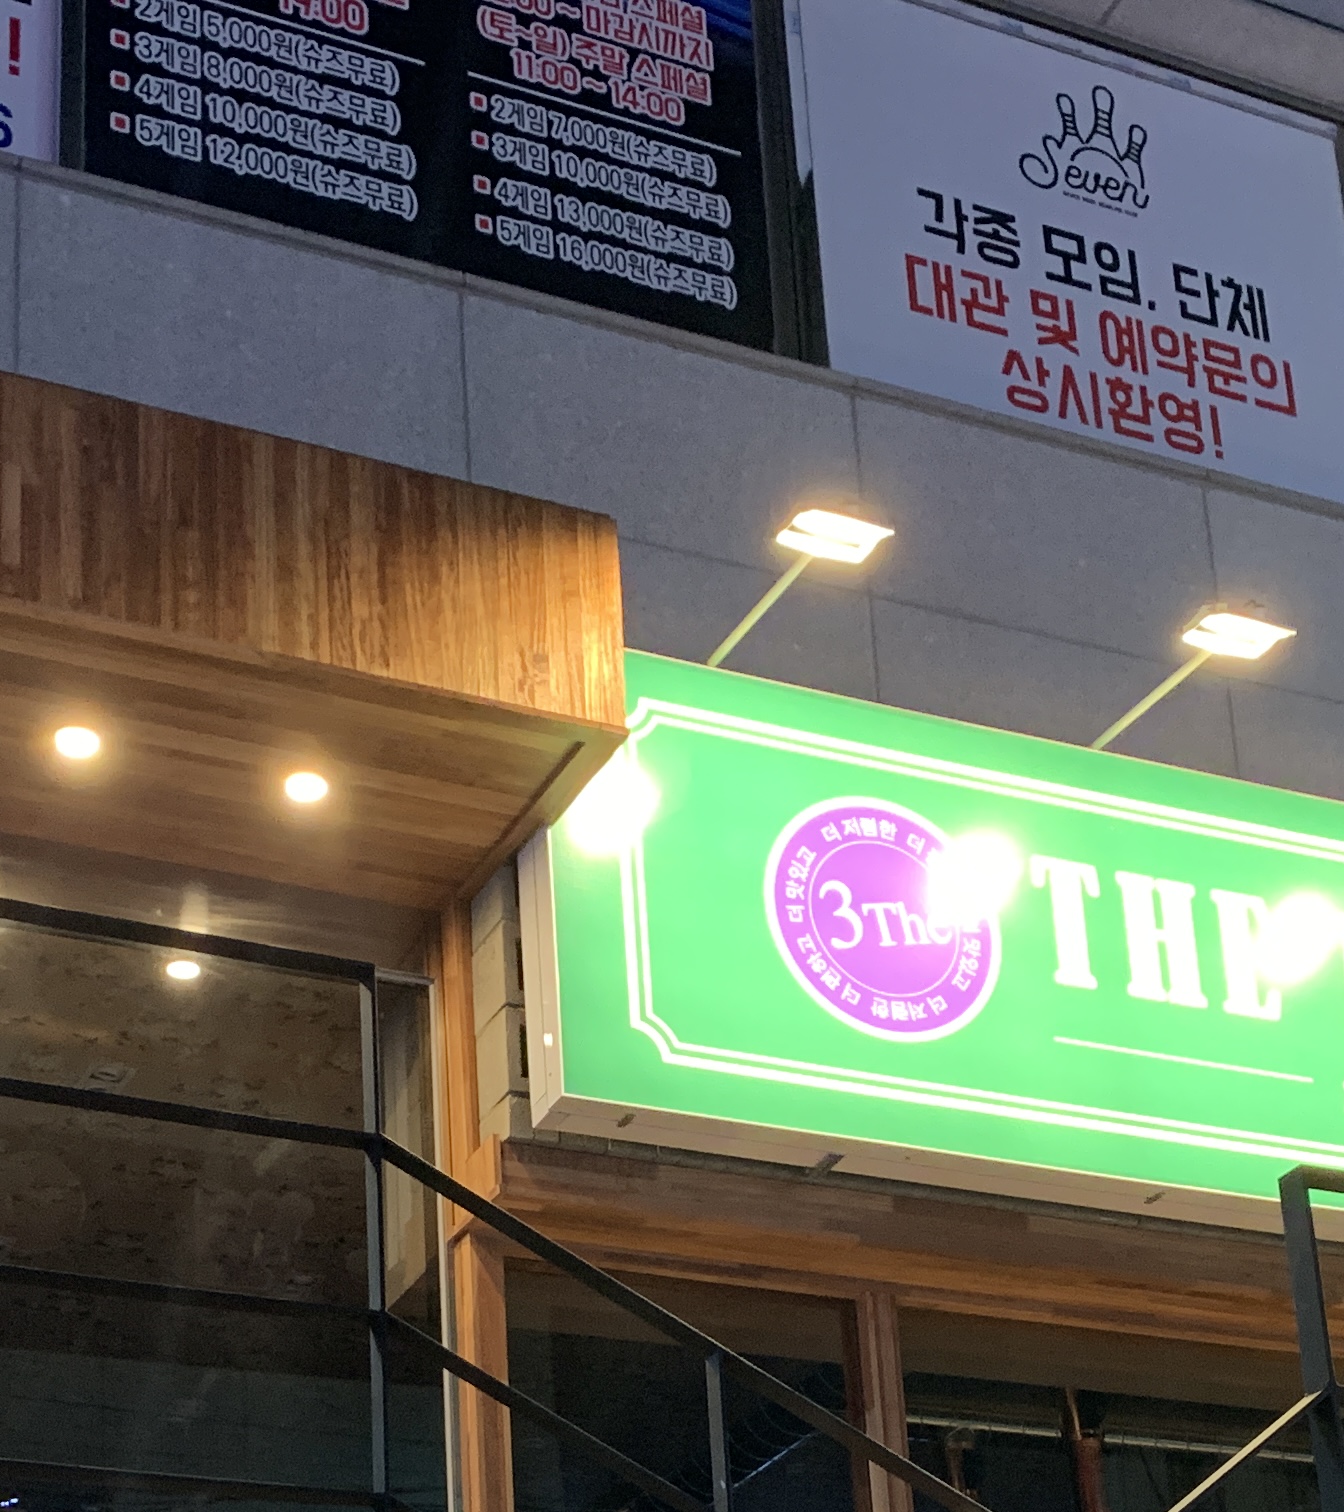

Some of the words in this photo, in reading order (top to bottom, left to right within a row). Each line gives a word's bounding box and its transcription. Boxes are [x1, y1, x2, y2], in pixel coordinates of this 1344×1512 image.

[134, 32, 201, 78] 3게임
[572, 33, 629, 79] 주말
[632, 52, 712, 105] 스페셜
[134, 74, 202, 120] 4게임
[491, 94, 548, 136] 2게임
[135, 115, 202, 161] 5게임
[491, 134, 549, 175] 3게임
[494, 178, 552, 220] 4게임
[496, 216, 555, 259] 5게임
[917, 188, 1021, 270] 각종
[1172, 263, 1271, 342] 단체
[905, 253, 1010, 337] 대관
[1029, 288, 1080, 355] 및
[1098, 310, 1297, 417] 예약문의
[1002, 349, 1224, 459] 상시환영!
[1031, 853, 1286, 1023] THE
